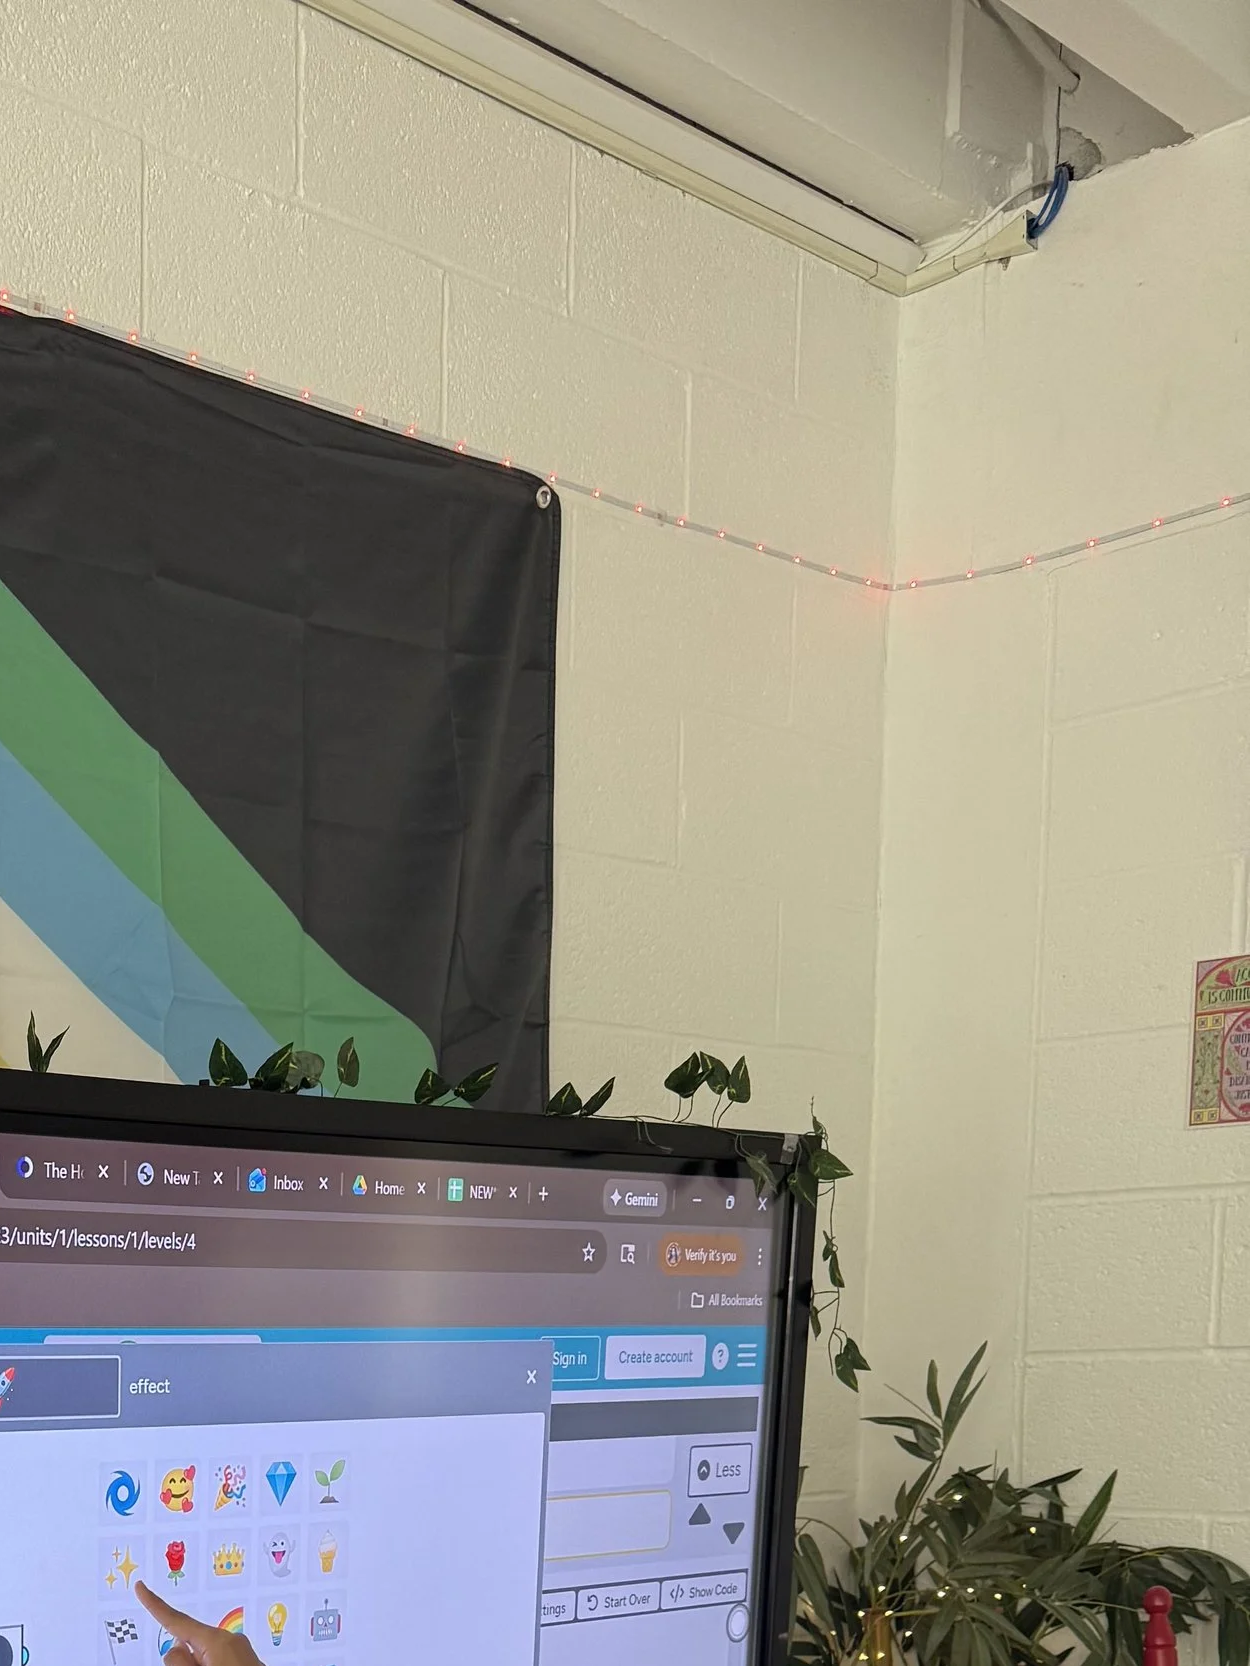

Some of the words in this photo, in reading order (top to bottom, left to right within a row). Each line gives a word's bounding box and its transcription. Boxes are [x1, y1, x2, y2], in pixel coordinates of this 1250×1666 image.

[44, 1161, 68, 1179] The
[163, 1168, 191, 1186] New
[273, 1174, 304, 1192] Inbox
[375, 1179, 405, 1196] Home
[469, 1184, 497, 1200] NEW
[624, 1191, 659, 1207] Gemini
[684, 1248, 708, 1264] Verify
[708, 1249, 721, 1262] it's
[721, 1251, 737, 1265] you
[708, 1293, 719, 1306] All
[720, 1293, 763, 1307] Bookmarks
[552, 1350, 576, 1369] Sign
[577, 1350, 587, 1366] in
[618, 1350, 651, 1364] Create
[654, 1350, 693, 1363] account
[129, 1378, 170, 1395] effect
[715, 1461, 741, 1478] Less
[689, 1586, 713, 1599] Show
[715, 1583, 738, 1596] Code
[604, 1596, 627, 1609] Start
[628, 1594, 651, 1607] Over
